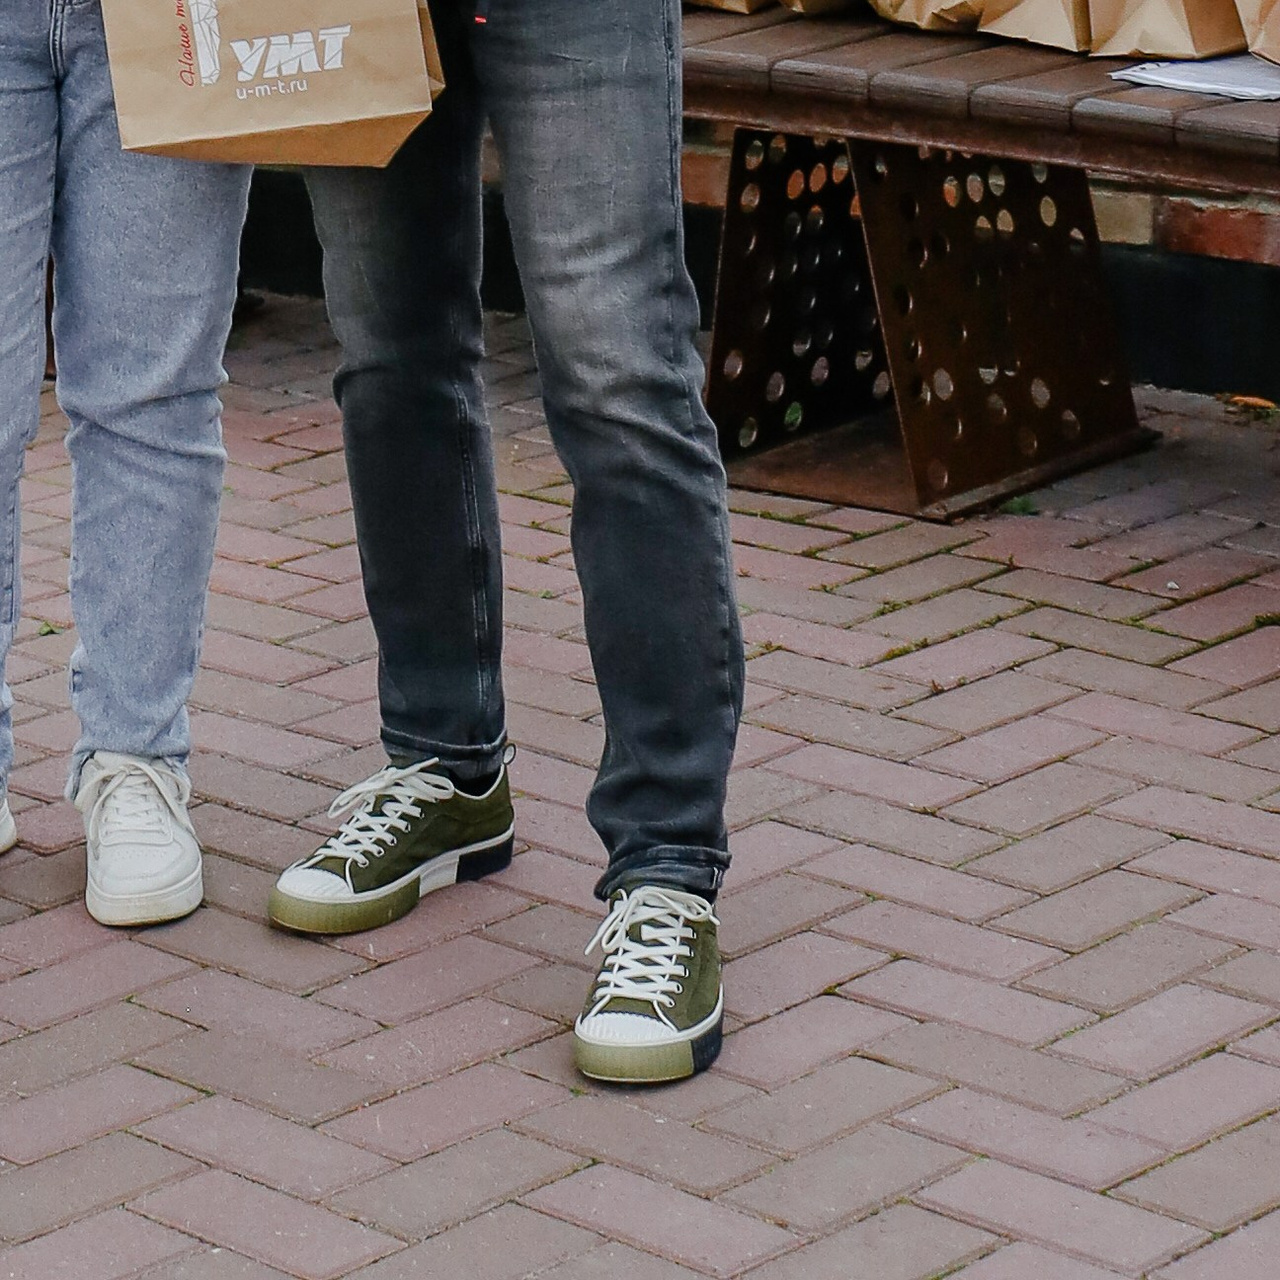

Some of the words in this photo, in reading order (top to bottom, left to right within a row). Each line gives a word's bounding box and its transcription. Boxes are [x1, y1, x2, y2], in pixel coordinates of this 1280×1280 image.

[179, 23, 195, 87] Наше
[229, 23, 352, 82] УМТ
[235, 79, 308, 100] u-m-t.ru
